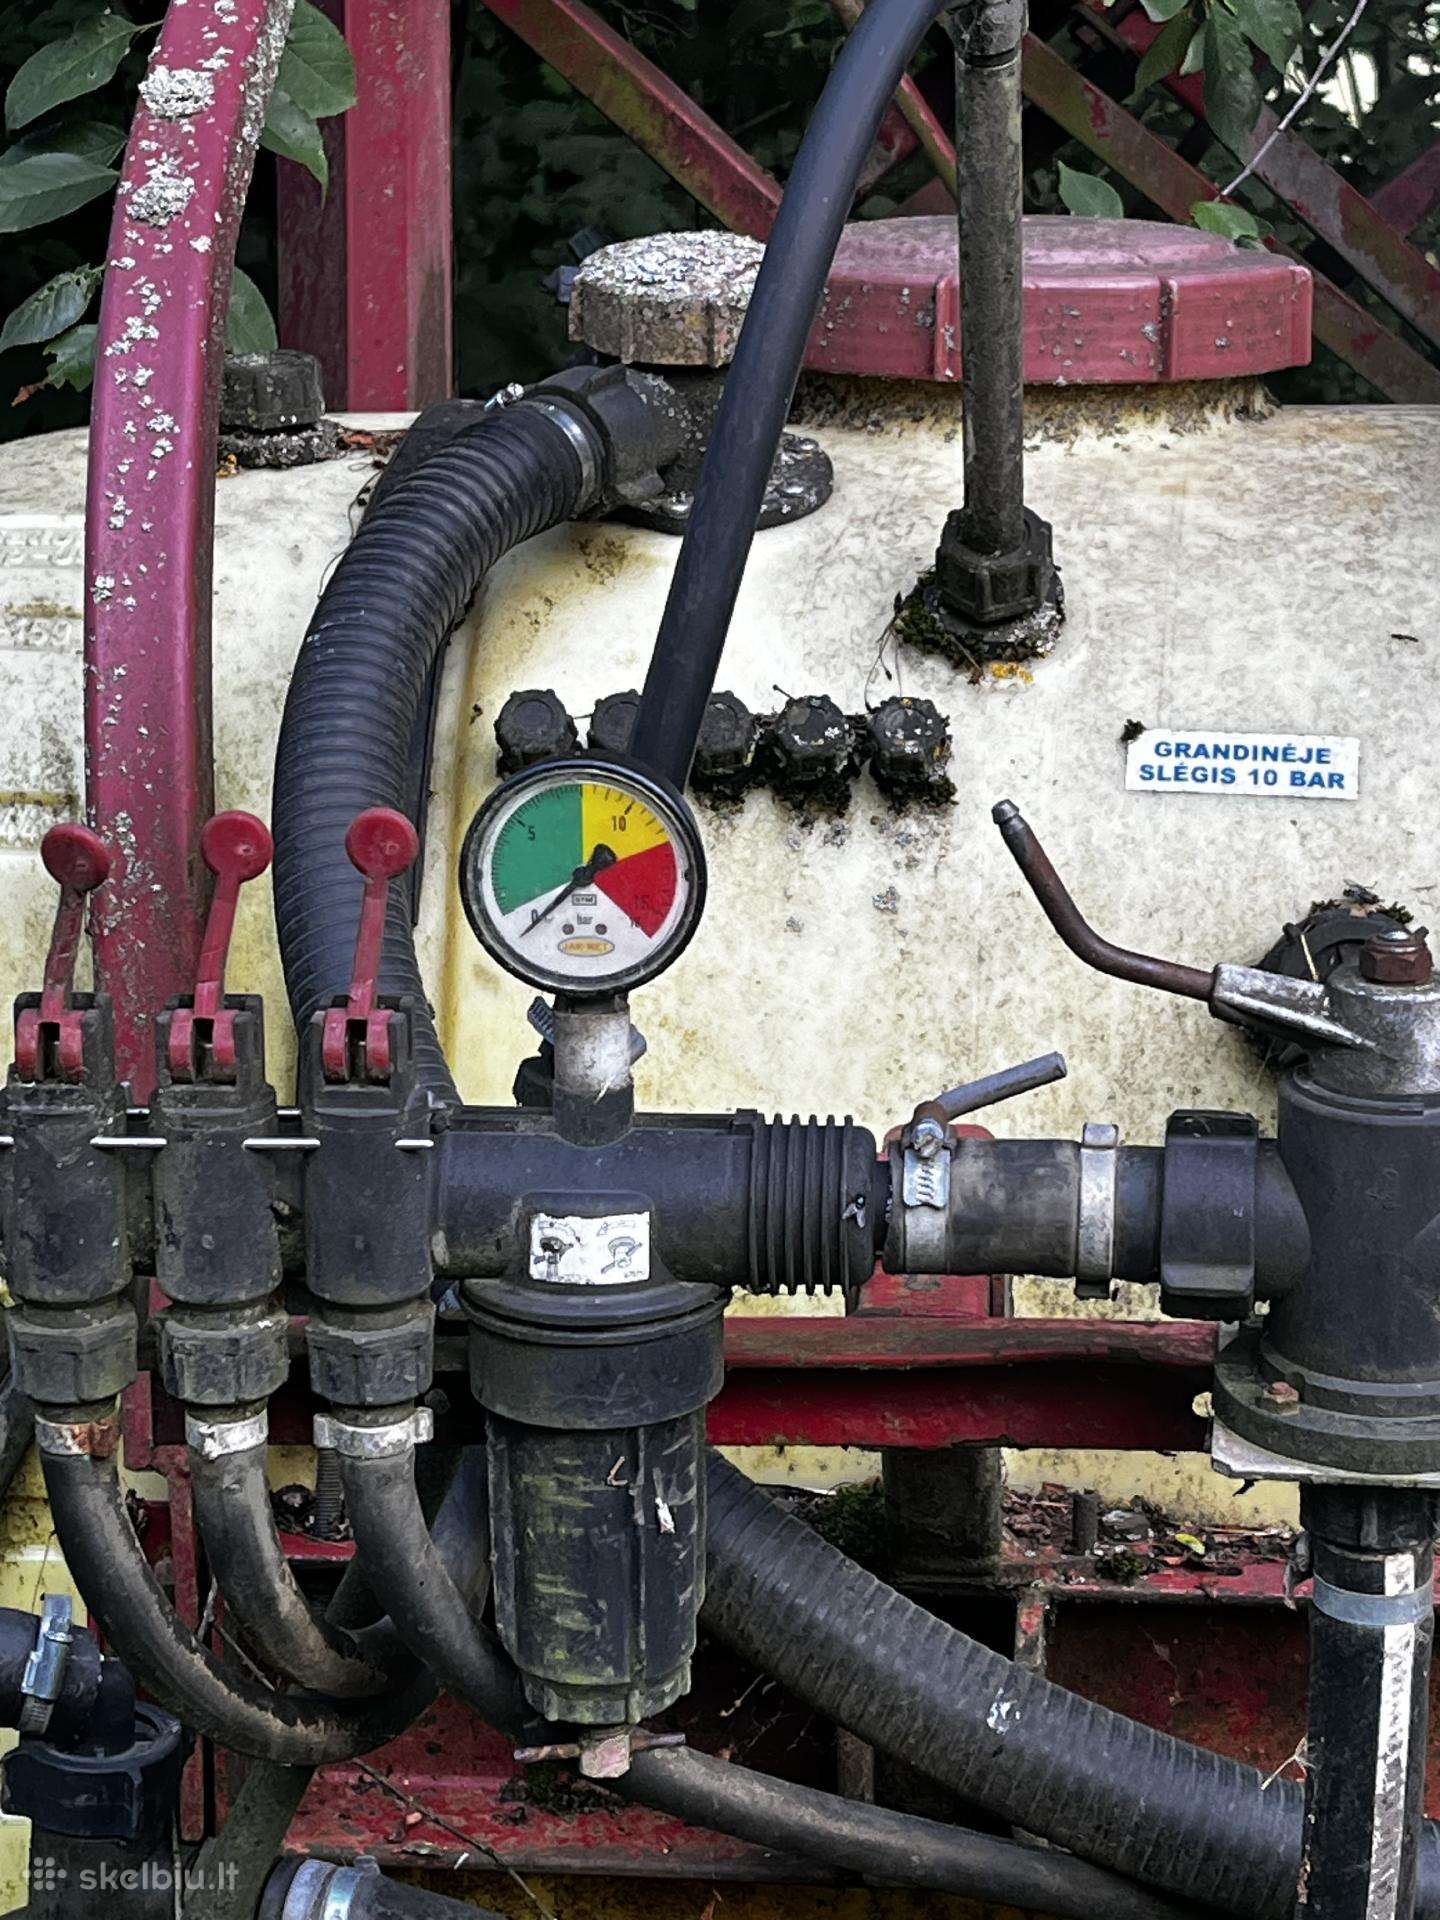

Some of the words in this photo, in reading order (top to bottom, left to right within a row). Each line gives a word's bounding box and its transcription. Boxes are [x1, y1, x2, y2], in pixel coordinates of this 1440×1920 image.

[1153, 741, 1332, 764] GRANDINĖJE
[1247, 768, 1278, 786] 10
[1289, 770, 1345, 789] BAR
[612, 815, 627, 832] 10
[527, 825, 536, 841] 5
[576, 912, 593, 925] bar
